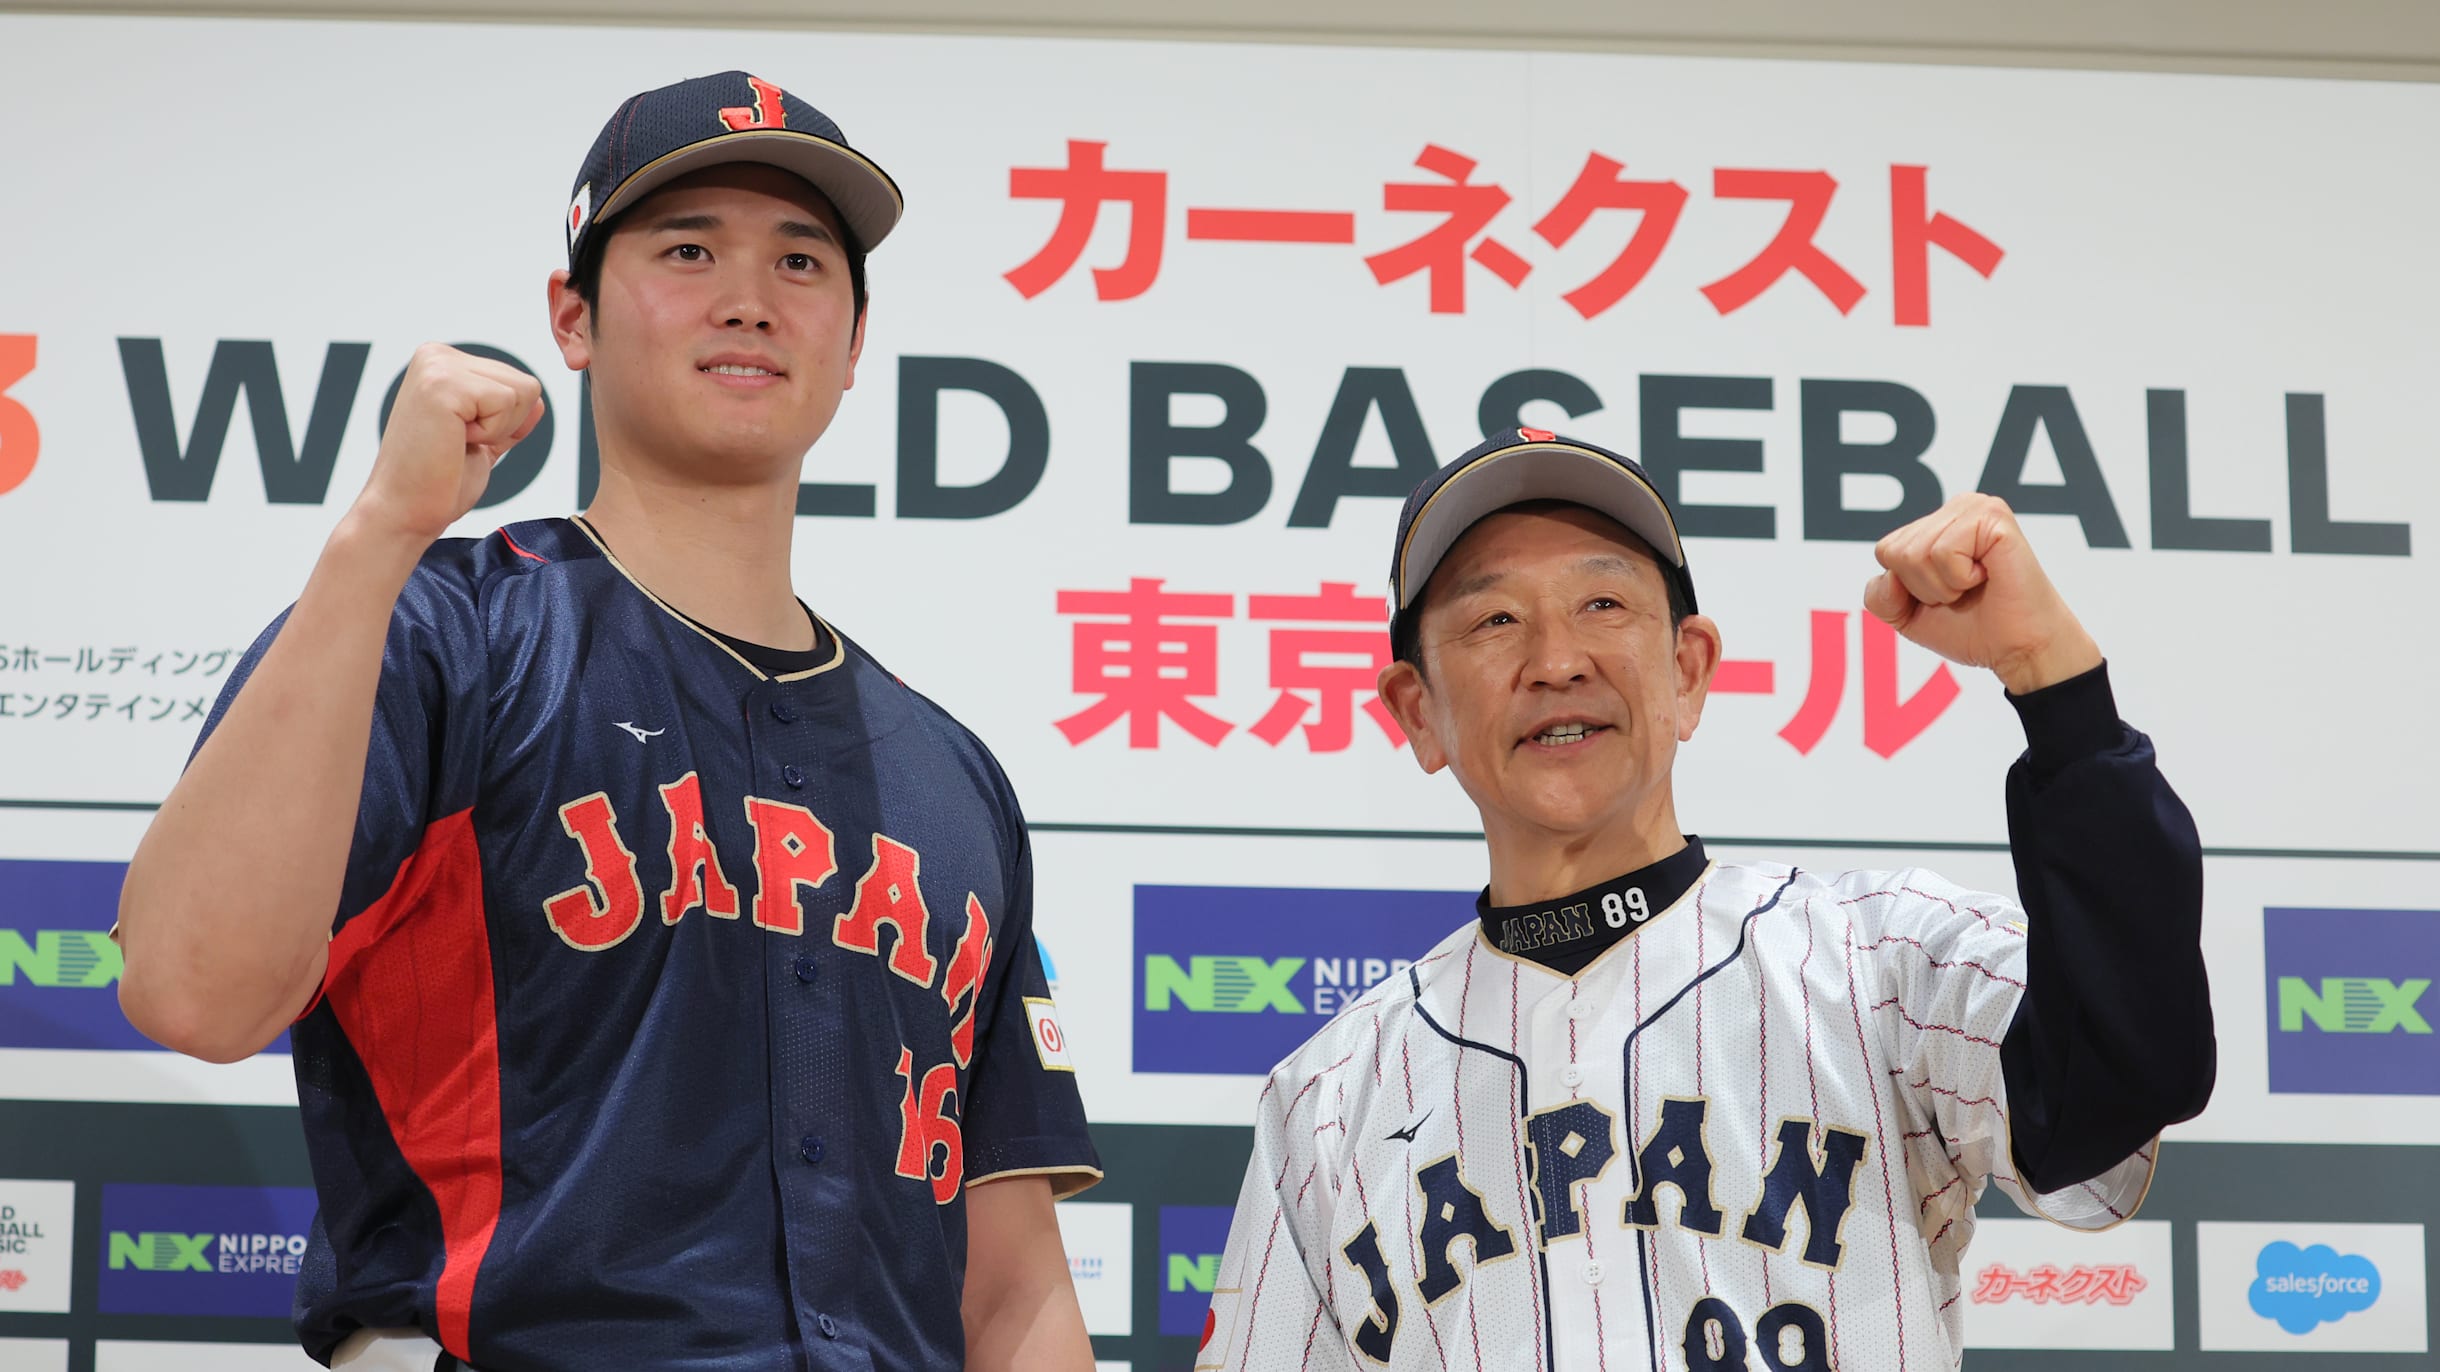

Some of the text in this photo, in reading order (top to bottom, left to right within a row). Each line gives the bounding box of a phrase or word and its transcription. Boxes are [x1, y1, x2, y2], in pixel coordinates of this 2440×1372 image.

[718, 76, 787, 129] J
[1001, 138, 2006, 328] カーネクスト
[1500, 887, 1650, 953] JAPAN 89
[1145, 954, 1306, 1013] NX
[2277, 976, 2433, 1034] NX
[894, 1042, 964, 1206] 16
[109, 1231, 214, 1272] NX
[1340, 1095, 1871, 1364] JAPAN
[218, 1254, 304, 1274] EXPRE
[1973, 1265, 2146, 1304] カーネクスト
[2265, 1272, 2370, 1298] salesforce
